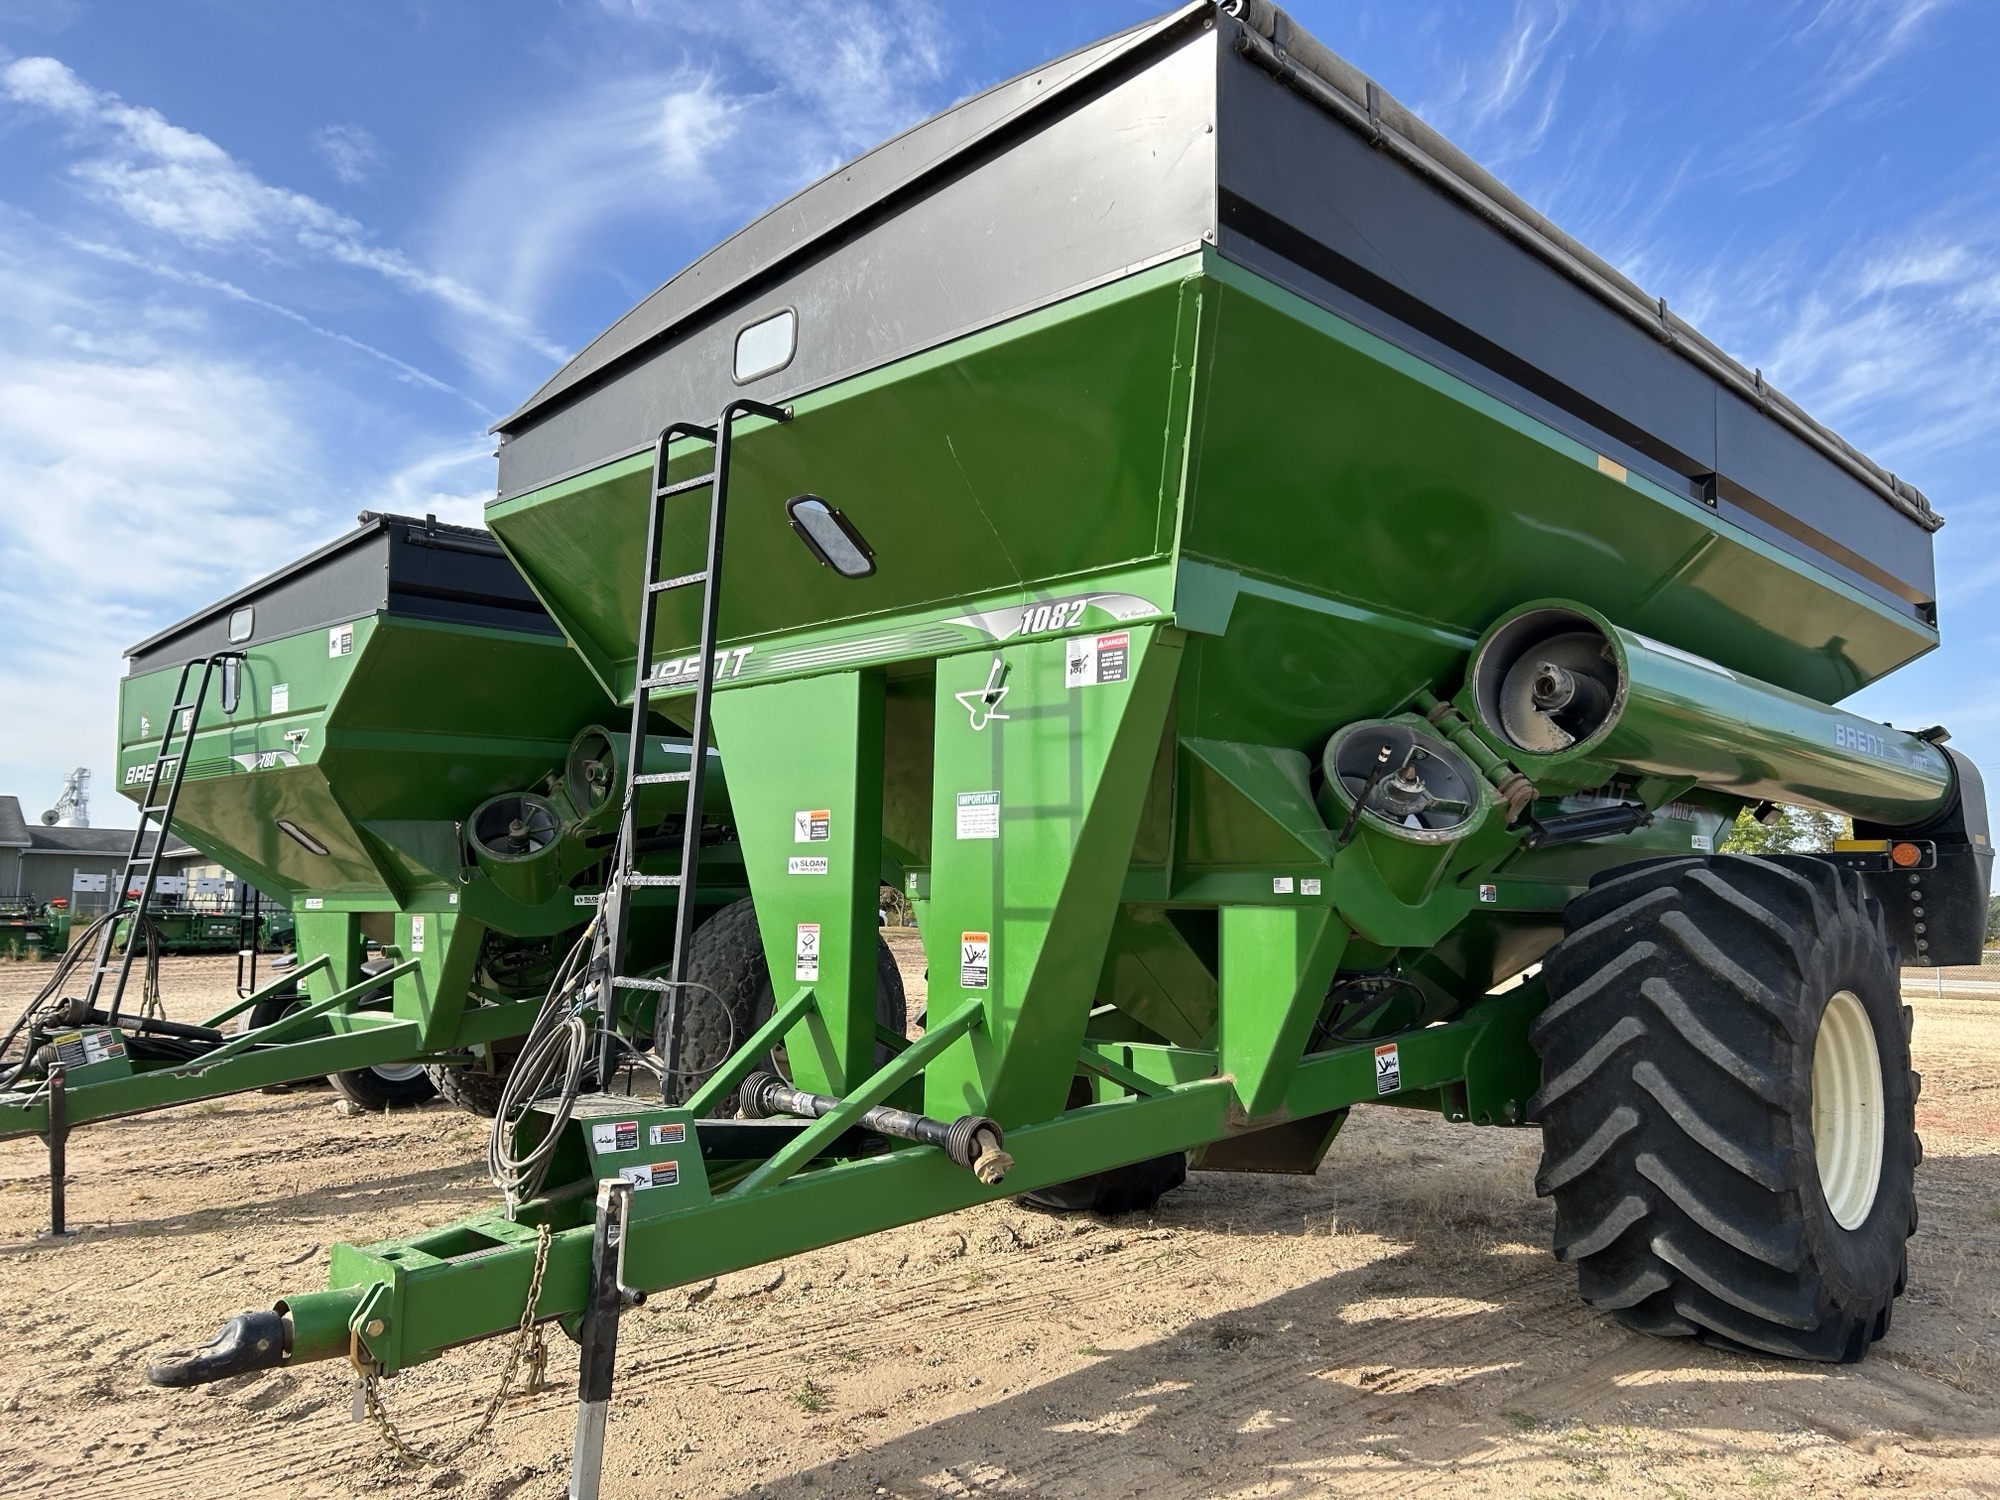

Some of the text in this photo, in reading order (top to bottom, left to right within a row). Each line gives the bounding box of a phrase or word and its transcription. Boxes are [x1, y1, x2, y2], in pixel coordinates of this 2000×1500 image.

[1020, 599, 1088, 636] 1082
[1834, 723, 1885, 757] BRENT
[259, 751, 277, 769] 780
[959, 793, 998, 806] IMPORTANT
[1671, 801, 1696, 822] 1082
[800, 859, 827, 867] SLOAN
